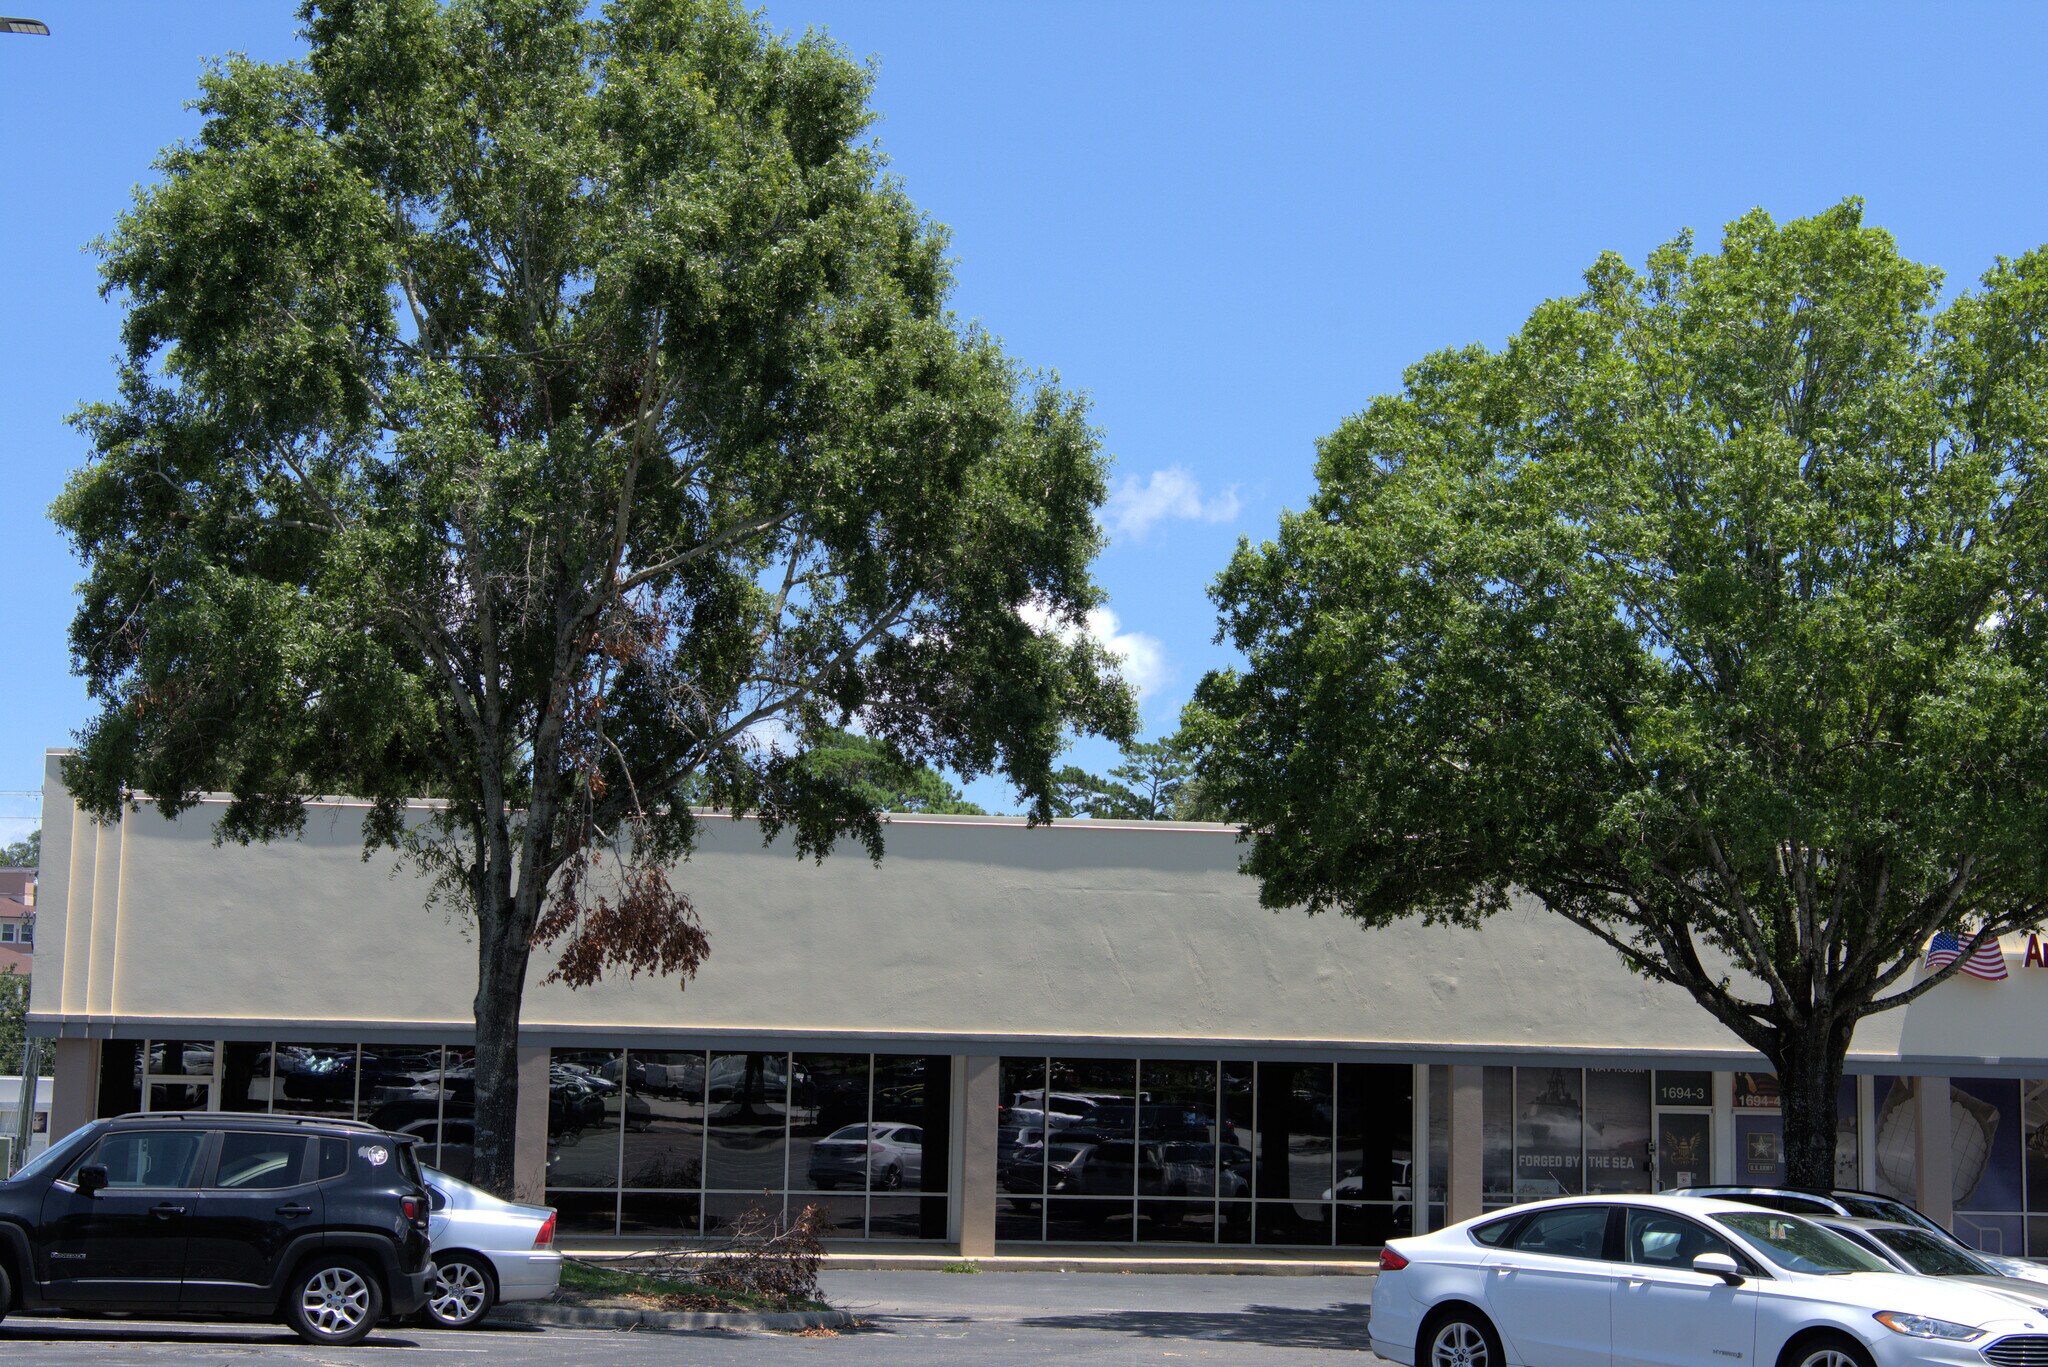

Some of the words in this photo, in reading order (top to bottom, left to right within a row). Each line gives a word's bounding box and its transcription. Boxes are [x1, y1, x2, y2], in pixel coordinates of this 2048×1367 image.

[1661, 1087, 1705, 1100] 1694-3
[1739, 1095, 1781, 1107] 1694-4
[1519, 1155, 1563, 1168] FORGED
[1565, 1156, 1580, 1168] BY
[1589, 1156, 1610, 1168] THE
[1612, 1157, 1635, 1169] SEA
